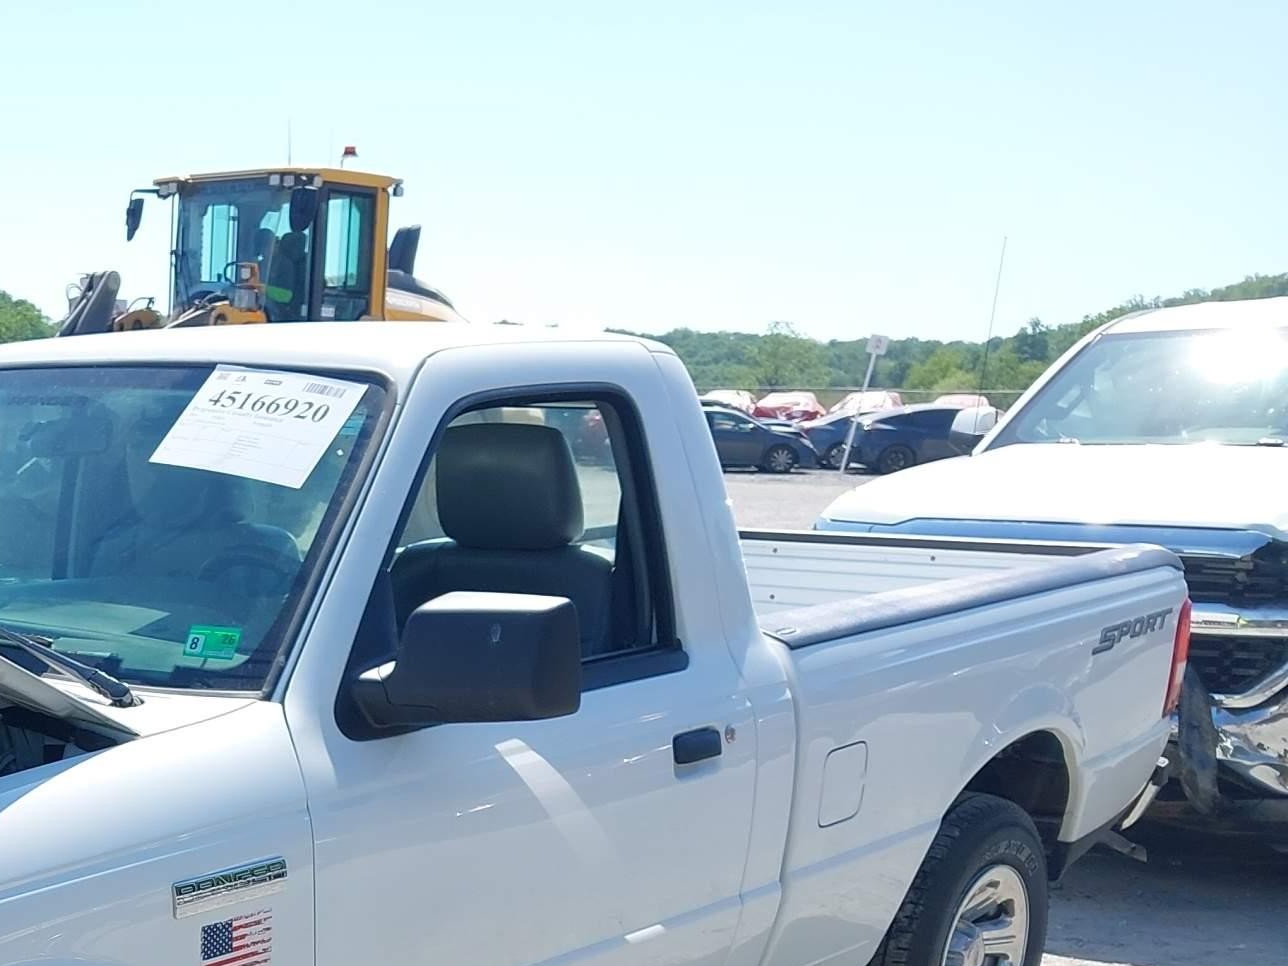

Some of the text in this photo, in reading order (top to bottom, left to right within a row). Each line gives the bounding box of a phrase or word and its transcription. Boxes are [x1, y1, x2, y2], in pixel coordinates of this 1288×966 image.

[208, 389, 330, 423] 45166920
[189, 636, 201, 650] 8
[1091, 607, 1174, 656] SPORT
